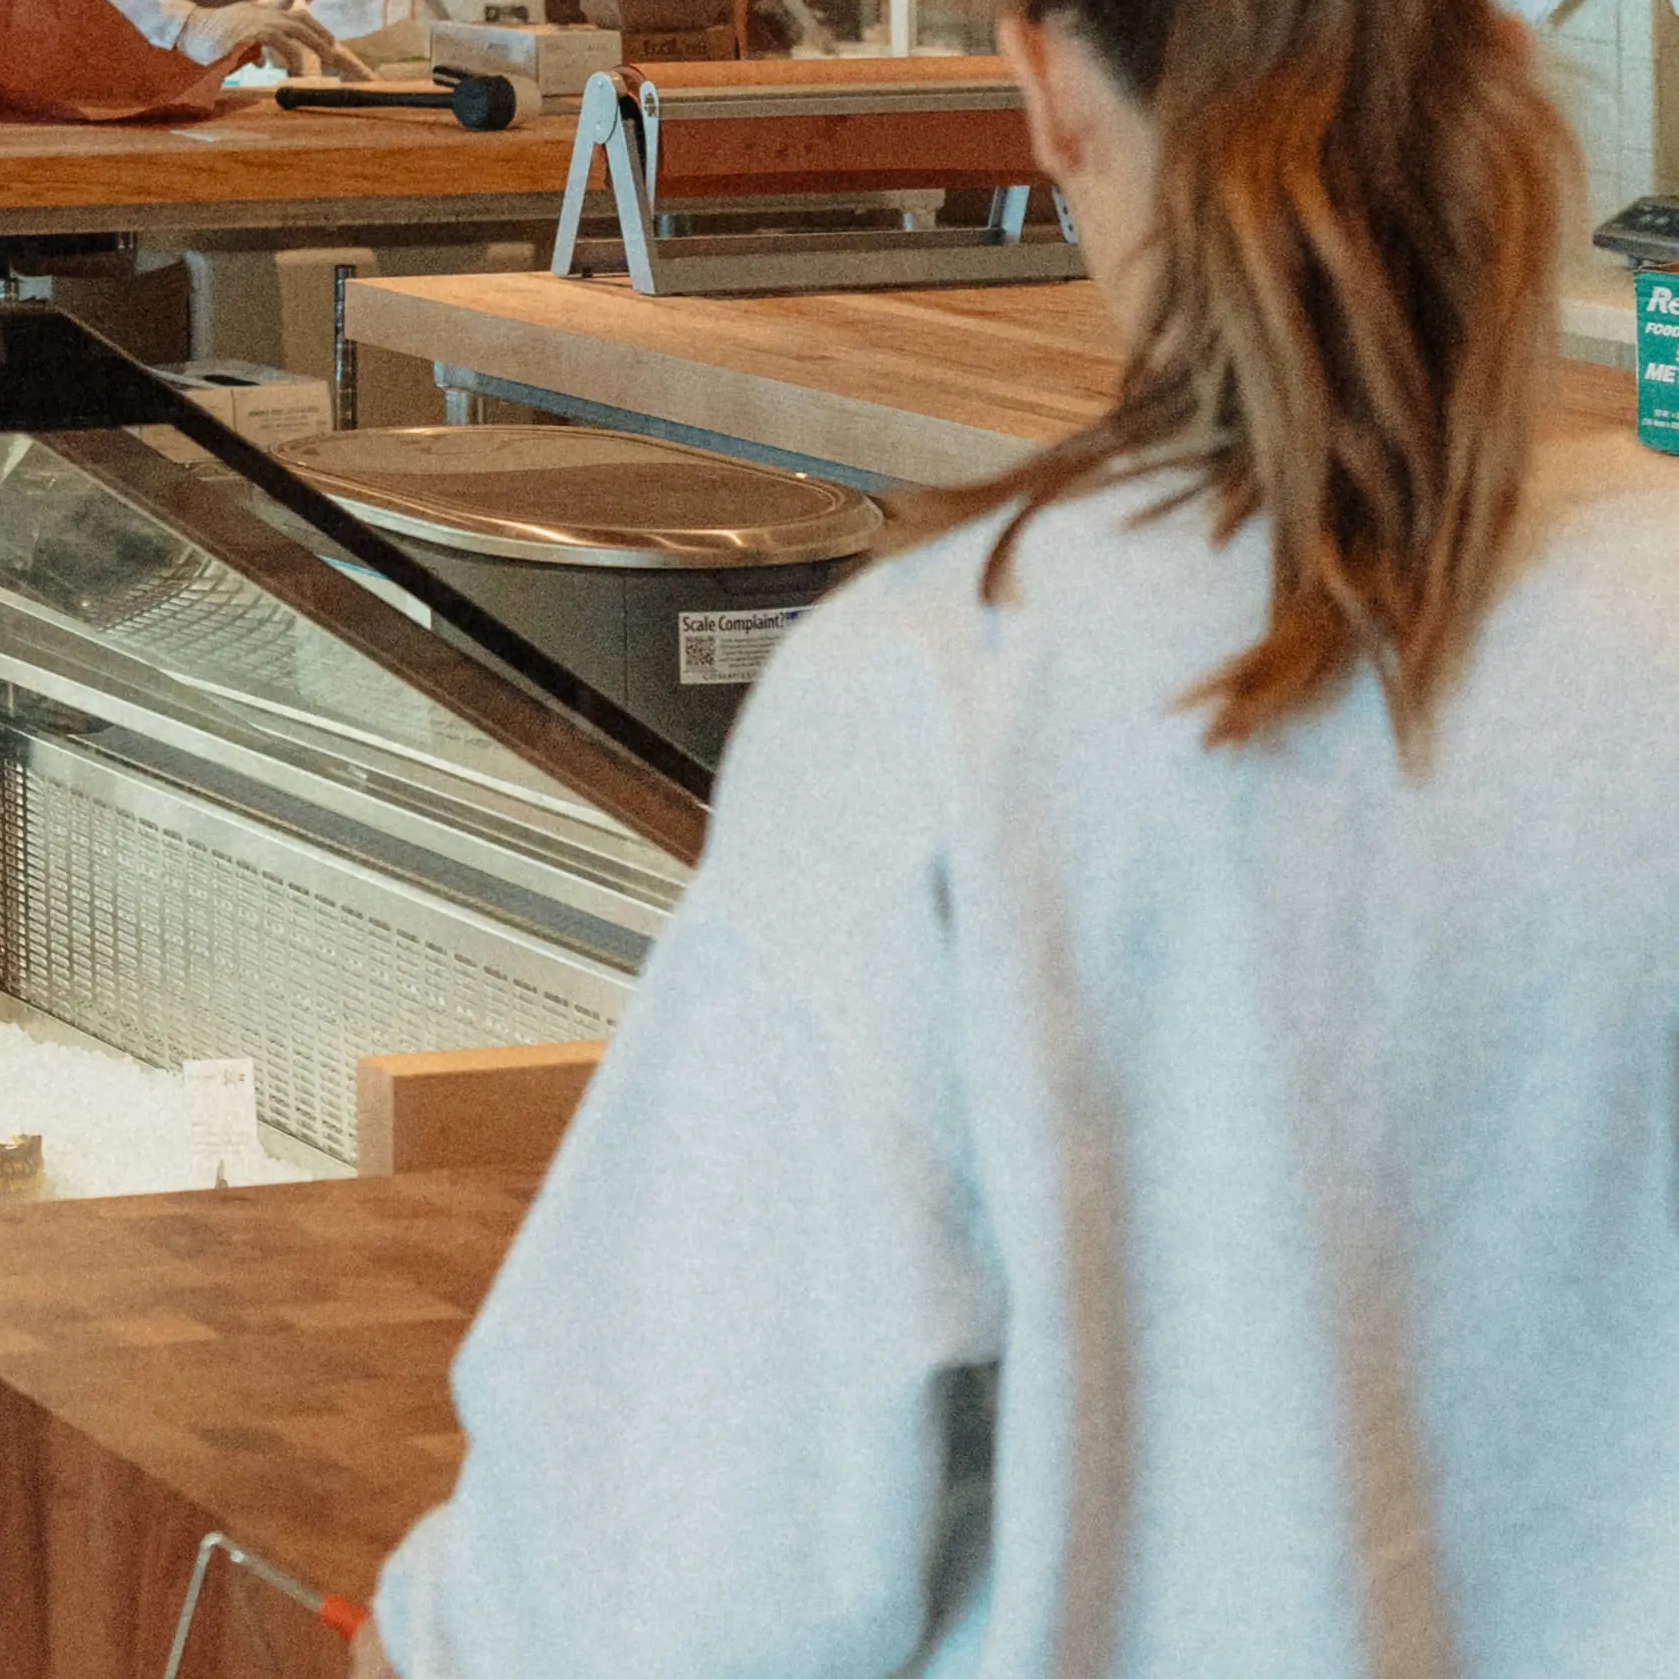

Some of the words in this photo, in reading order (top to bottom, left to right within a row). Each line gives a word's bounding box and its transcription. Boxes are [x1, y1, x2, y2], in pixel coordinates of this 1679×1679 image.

[1644, 362, 1679, 384] ME
[682, 616, 716, 632] Scale
[718, 612, 784, 635] Complaint?
